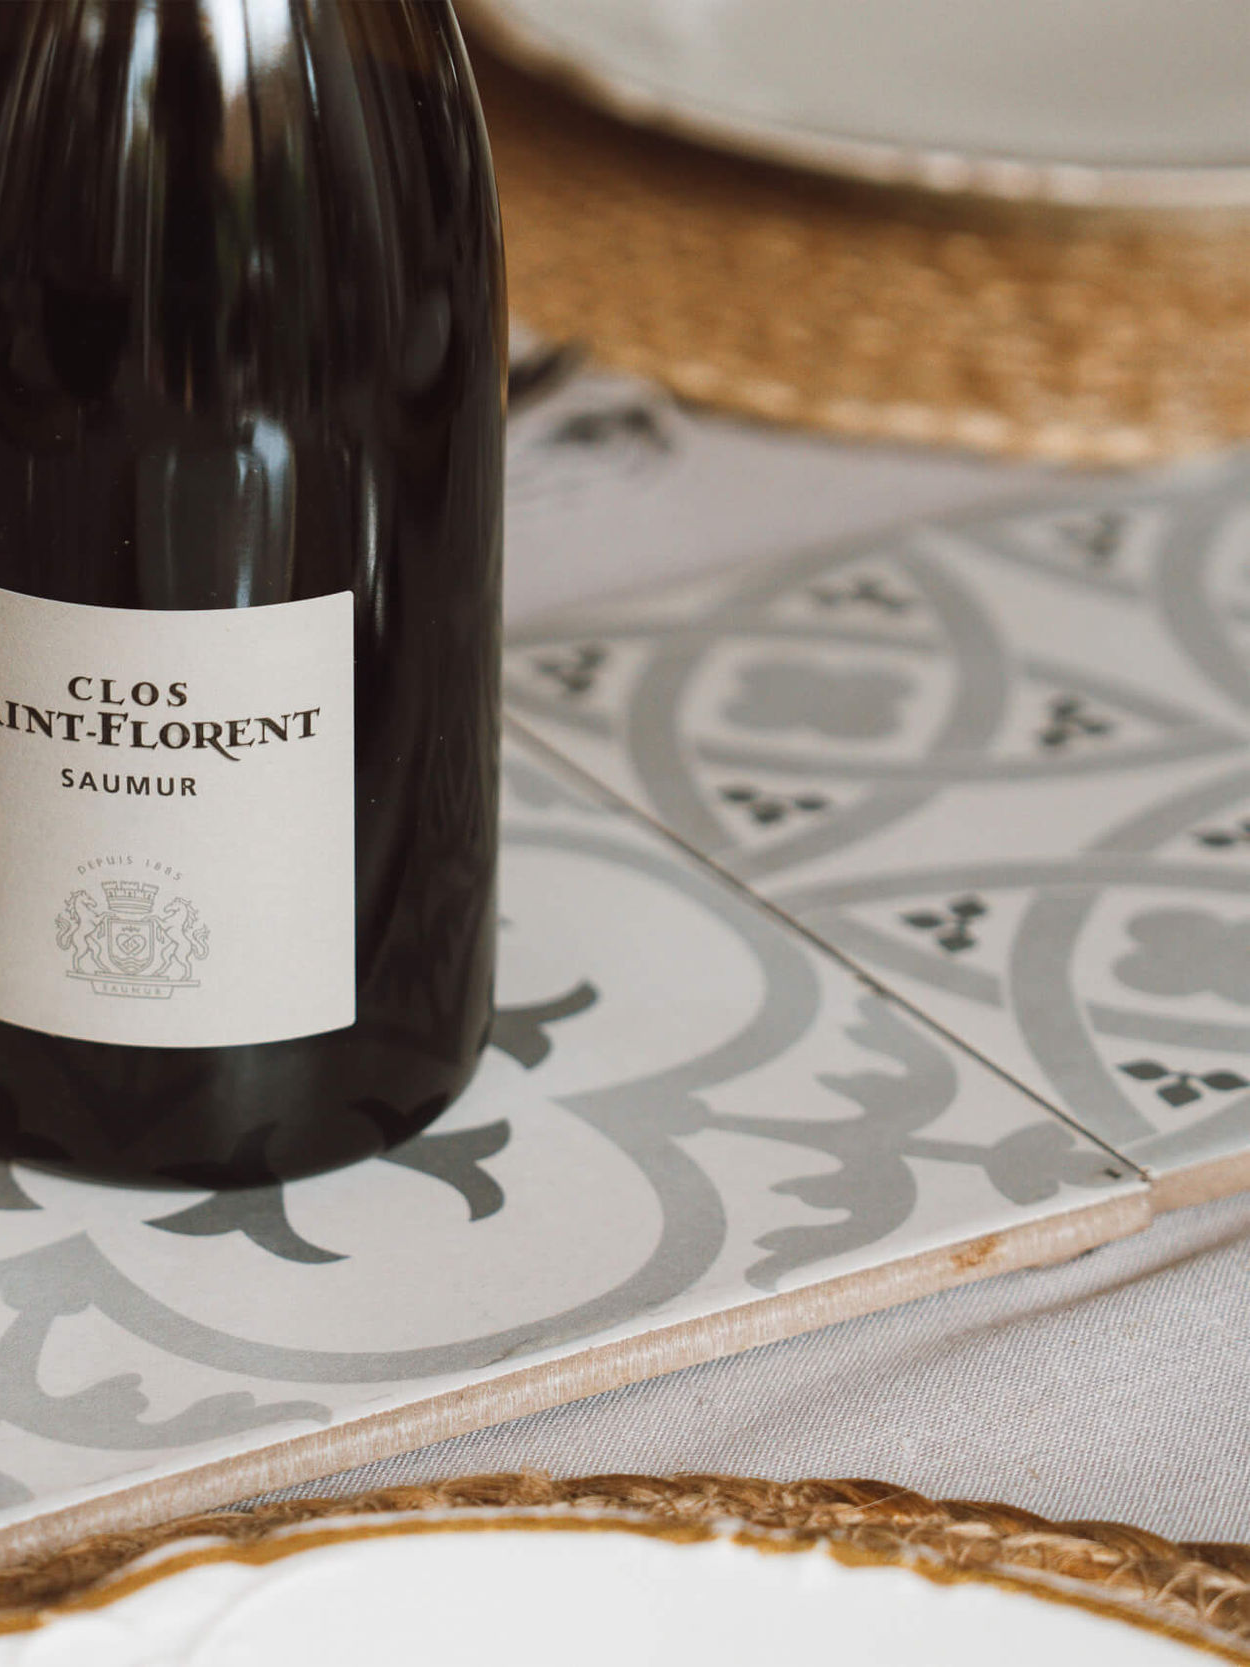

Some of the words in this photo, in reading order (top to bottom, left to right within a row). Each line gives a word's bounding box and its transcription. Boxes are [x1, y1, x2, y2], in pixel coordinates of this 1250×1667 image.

[68, 675, 188, 708] CLOS
[62, 768, 198, 796] SAUMUR
[77, 855, 133, 876] DEPUIS
